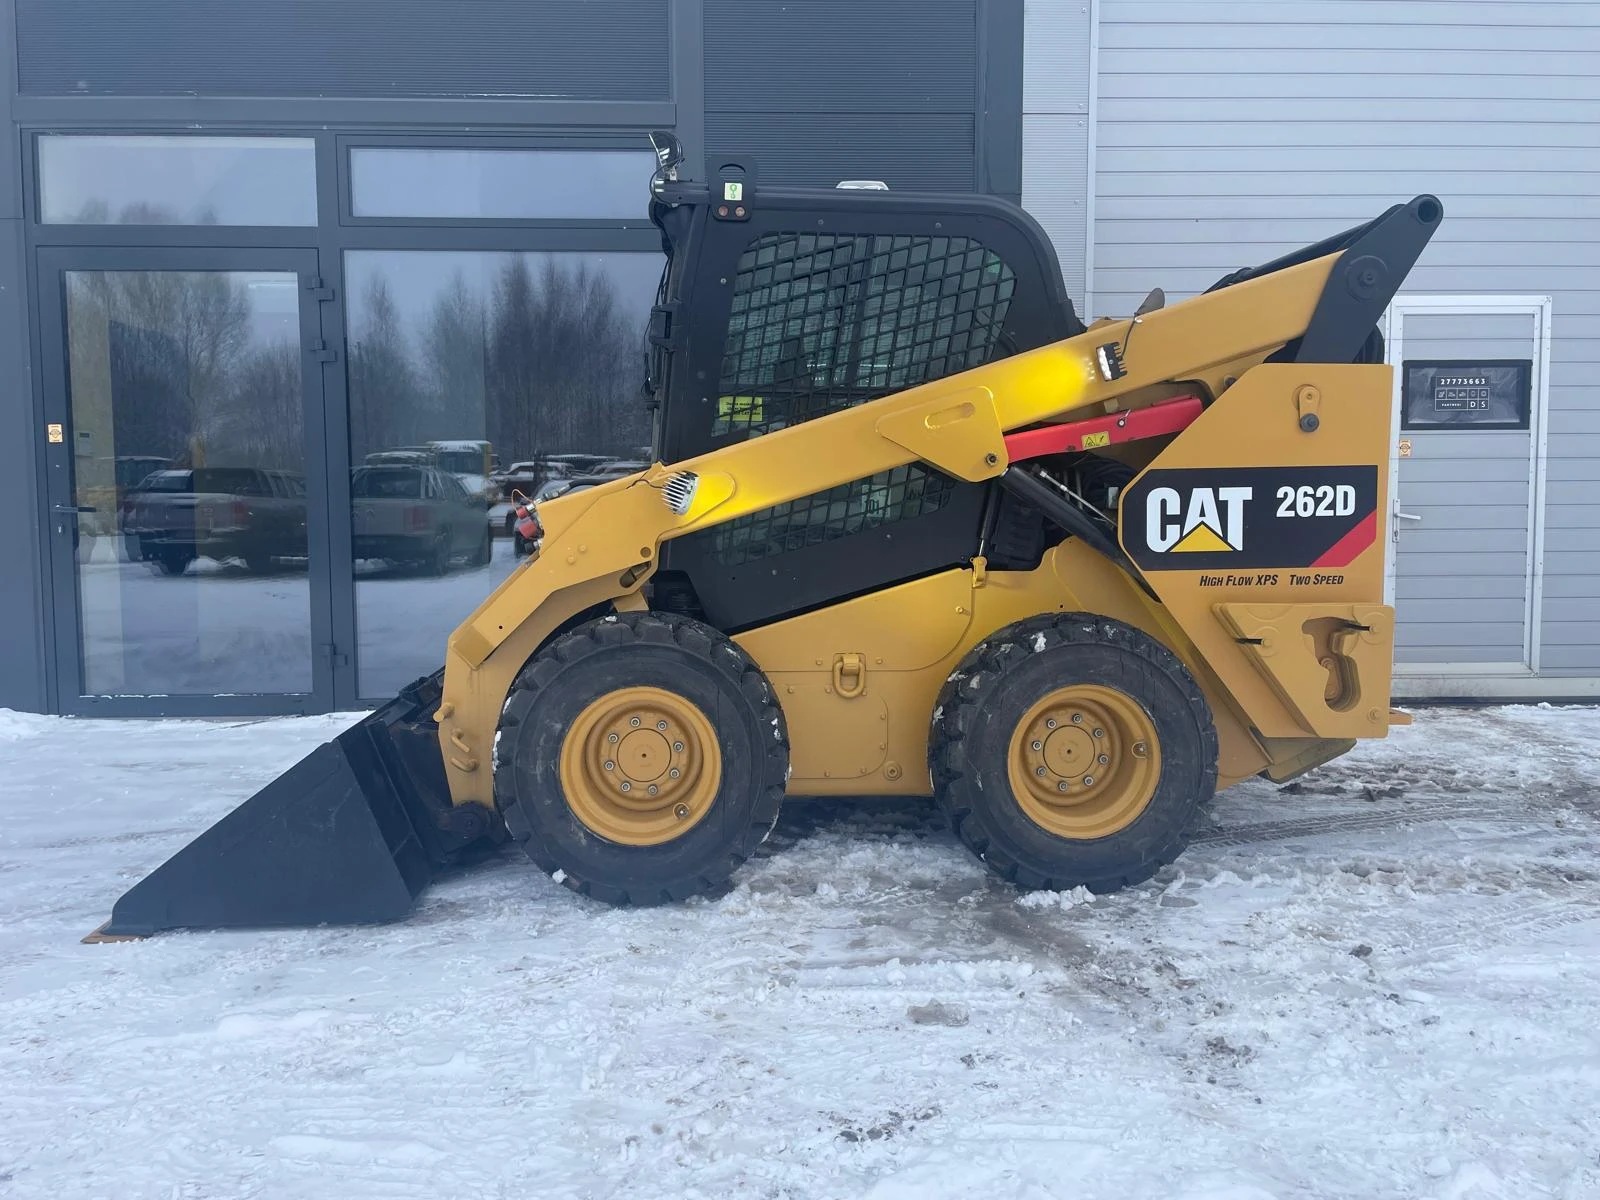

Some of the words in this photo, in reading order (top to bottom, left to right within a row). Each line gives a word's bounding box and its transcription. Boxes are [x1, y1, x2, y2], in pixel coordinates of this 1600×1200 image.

[1481, 400, 1486, 408] S
[1146, 486, 1253, 553] CAT
[1275, 484, 1356, 518] 262D
[1255, 574, 1279, 586] XPS
